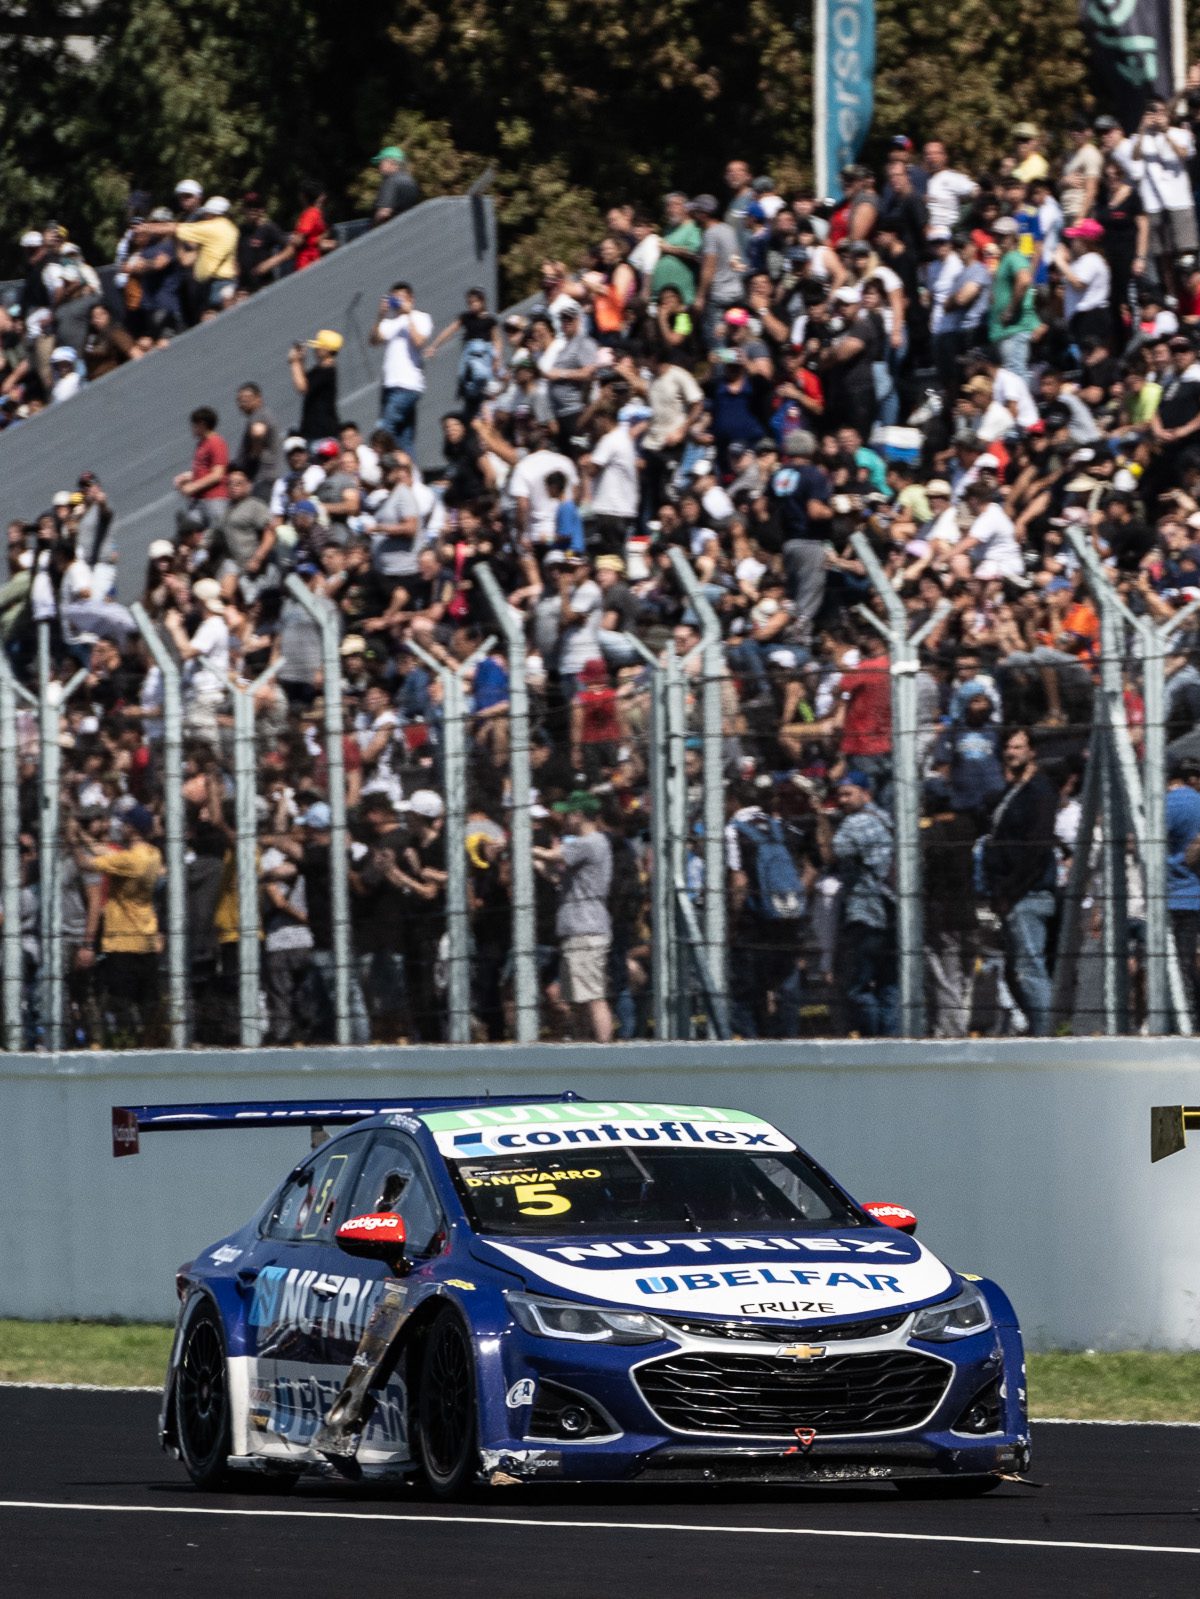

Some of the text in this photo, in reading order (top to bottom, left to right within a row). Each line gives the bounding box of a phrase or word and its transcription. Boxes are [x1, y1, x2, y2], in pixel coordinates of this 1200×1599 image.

[499, 1121, 781, 1149] contuflex
[465, 1168, 602, 1188] D.NAVARRO
[514, 1183, 572, 1216] 5
[545, 1237, 912, 1263] NUTRIEX
[634, 1268, 905, 1295] UBELFAR
[739, 1300, 837, 1315] CRUZE
